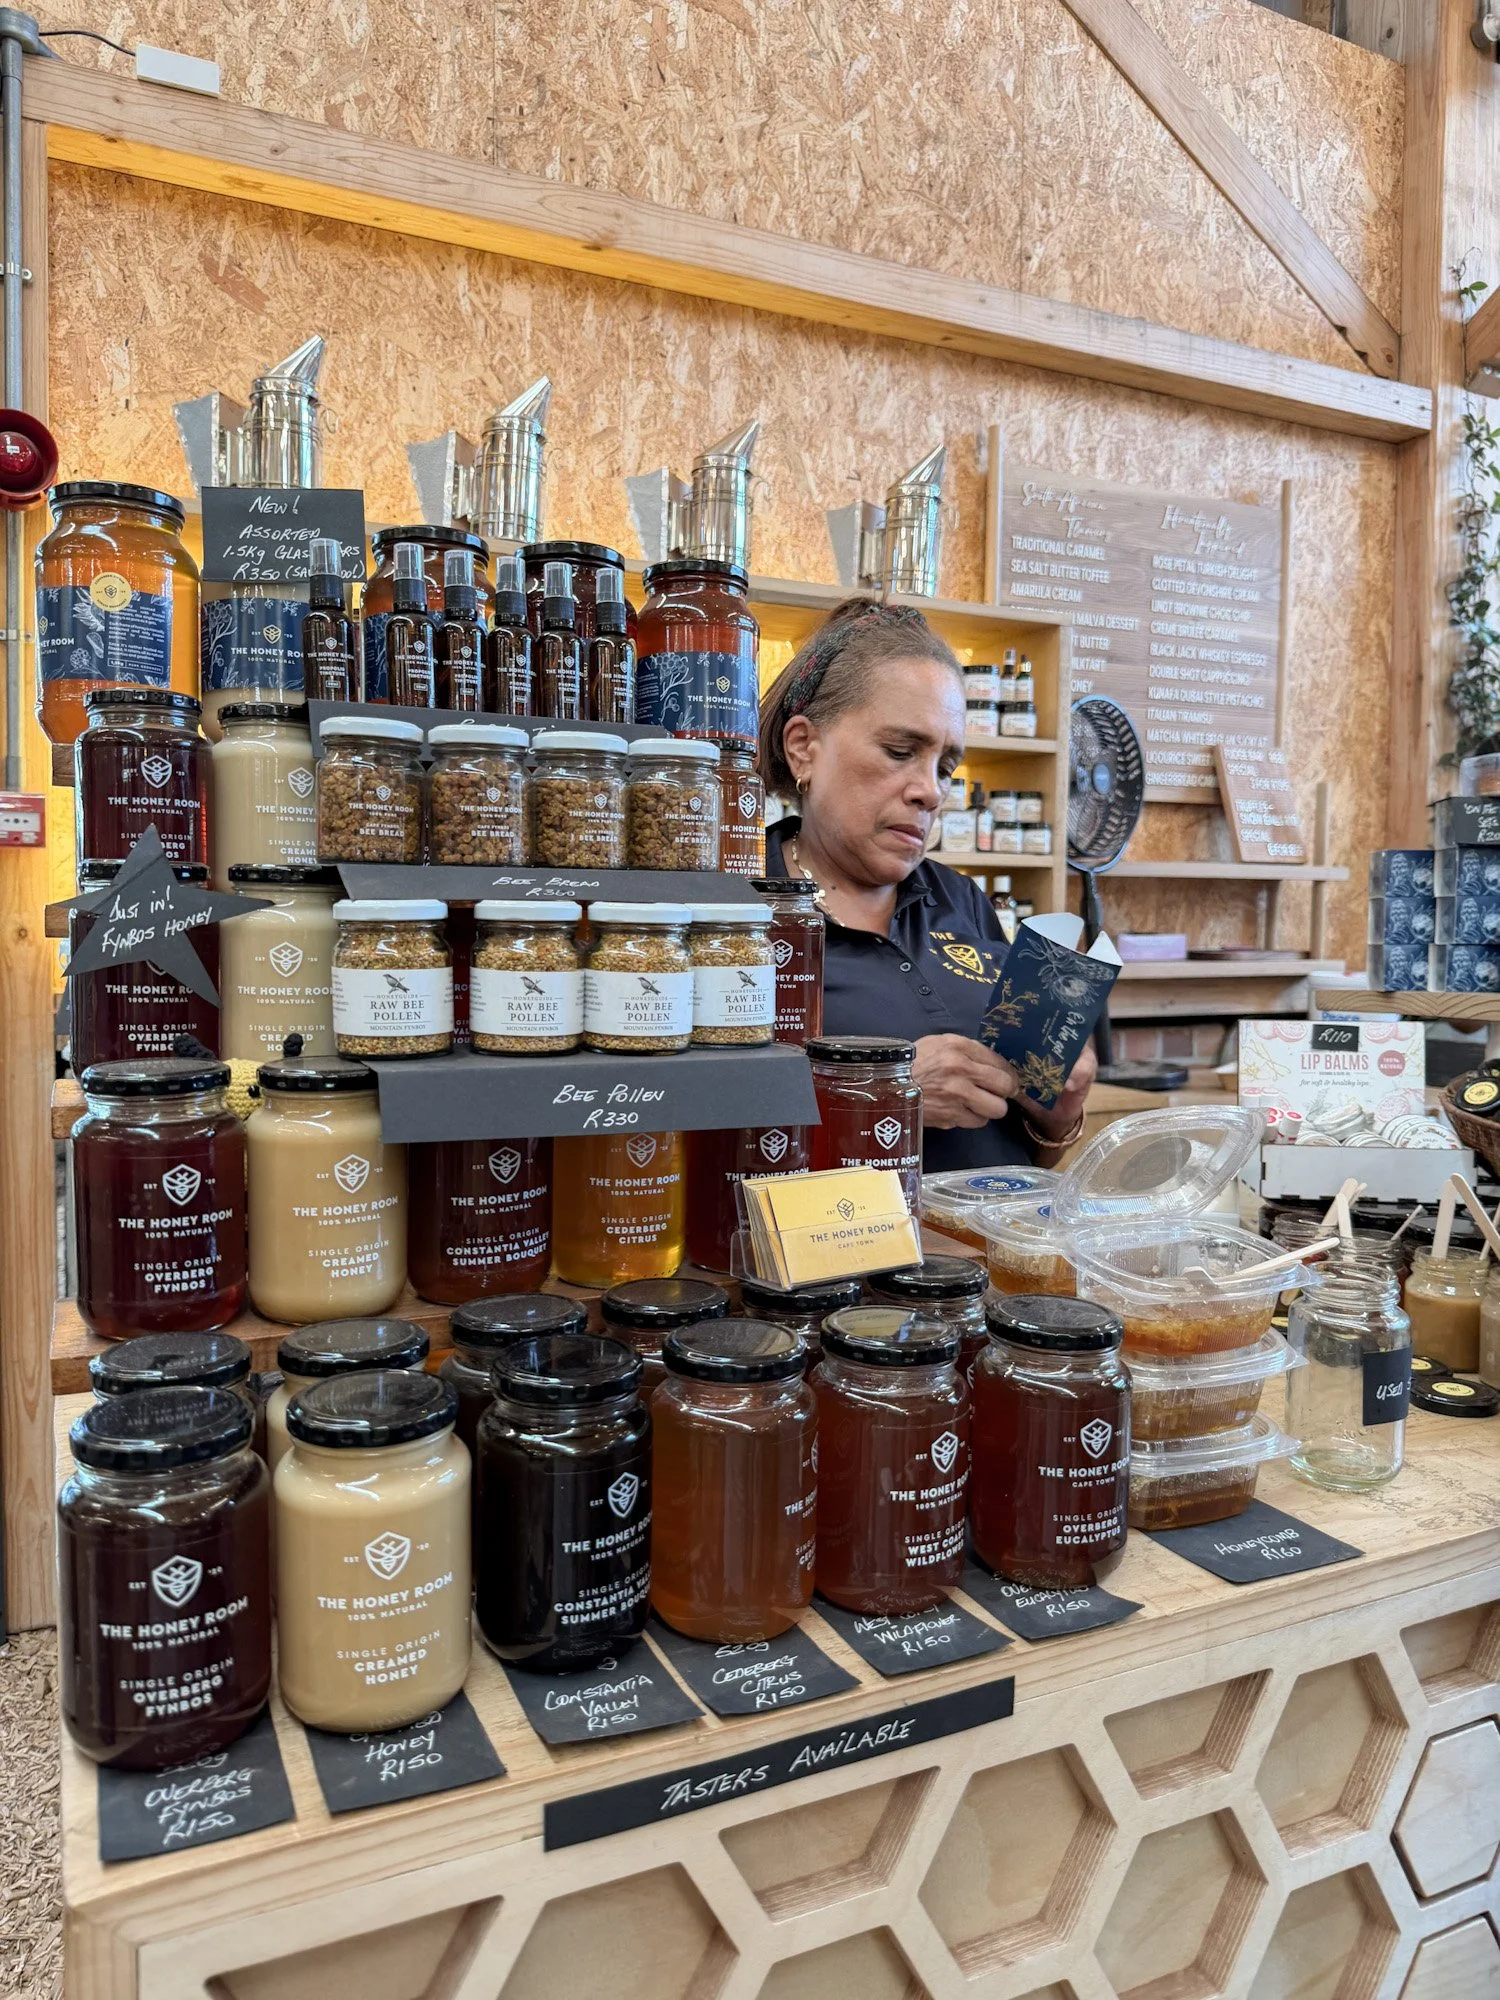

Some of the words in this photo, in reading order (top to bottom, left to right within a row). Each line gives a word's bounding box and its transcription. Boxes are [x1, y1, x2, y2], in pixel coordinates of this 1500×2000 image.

[239, 524, 320, 540] ASSORTED
[1012, 535, 1065, 555] TRADITIONAL
[1067, 543, 1105, 560] CARAMEL
[233, 562, 280, 580] R350
[1011, 559, 1028, 573] SEA
[1029, 562, 1048, 575] SALT
[1050, 564, 1081, 579] BUTTER
[1082, 568, 1110, 584] TOFFEE
[1010, 583, 1050, 598] AMARULA
[1052, 588, 1081, 602] CREAM
[1106, 616, 1139, 630] DESSERT
[251, 648, 284, 656] HONEY
[1080, 637, 1109, 650] BUTTER
[706, 696, 732, 704] HONEY
[1147, 729, 1180, 742] MATCHA
[379, 829, 404, 837] BREAD
[545, 878, 599, 887] BREAD
[526, 888, 575, 896] R360
[102, 928, 155, 957] FYNBOS
[164, 907, 212, 938] HONEY
[929, 932, 955, 940] THE
[370, 1001, 397, 1010] RAW
[403, 1000, 424, 1009] BEE
[507, 1002, 531, 1011] RAW
[538, 1003, 558, 1011] BEE
[624, 1002, 648, 1010] RAW
[374, 1011, 422, 1021] POLLEN
[510, 1013, 555, 1022] POLLEN
[627, 1013, 670, 1021] POLLEN
[1301, 1055, 1320, 1070] LIP
[1325, 1055, 1369, 1070] BALMS
[583, 1109, 639, 1128] R330
[293, 1207, 317, 1216] THE
[323, 1203, 368, 1216] HONEY
[119, 1218, 144, 1228] THE
[150, 1216, 198, 1228] HONEY
[606, 1223, 667, 1234] CEDERBERG
[619, 1234, 657, 1244] CITRUS
[810, 1234, 829, 1243] THE
[832, 1229, 864, 1239] HONEY
[868, 1224, 895, 1234] ROOM
[323, 1252, 379, 1267] CREAMED
[145, 1267, 213, 1282] OVERBERG
[332, 1265, 372, 1278] HONEY
[154, 1280, 206, 1293] FYNBOS
[1376, 1382, 1403, 1400] USED
[1039, 1467, 1064, 1477] THE
[1069, 1465, 1109, 1477] HONEY
[921, 1481, 956, 1499] HONEY
[1063, 1517, 1117, 1532] OVERBERG
[596, 1527, 635, 1548] HONEY
[1056, 1526, 1120, 1544] EUCALYPTUS
[1214, 1528, 1300, 1555] HONEYCOMB
[908, 1542, 939, 1555] WEST
[1261, 1547, 1301, 1560] R160
[578, 1581, 620, 1598] SINGLE
[353, 1590, 409, 1609] HONEY
[554, 1585, 634, 1612] CONSTANTIA
[381, 1601, 427, 1618] NATURAL
[561, 1607, 616, 1624] SUMMER
[1046, 1600, 1090, 1617] R150
[100, 1624, 132, 1638] THE
[139, 1616, 200, 1637] HONEY
[168, 1627, 220, 1645] NATURAL
[396, 1630, 440, 1652] ORIGIN
[901, 1635, 950, 1655] R150
[354, 1649, 426, 1671] CREAMED
[120, 1676, 175, 1689] SINGLE
[366, 1665, 418, 1684] HONEY
[133, 1675, 223, 1704] OVERBERG
[755, 1685, 805, 1709] R150
[145, 1693, 212, 1717] FYNBOS
[588, 1713, 637, 1731] R150
[364, 1730, 434, 1762] HONEY
[380, 1753, 442, 1781] R150
[144, 1768, 254, 1807] OVERBERG
[661, 1765, 769, 1810] TASTERS
[158, 1786, 252, 1824] FYNBOS
[162, 1811, 235, 1845] R150
